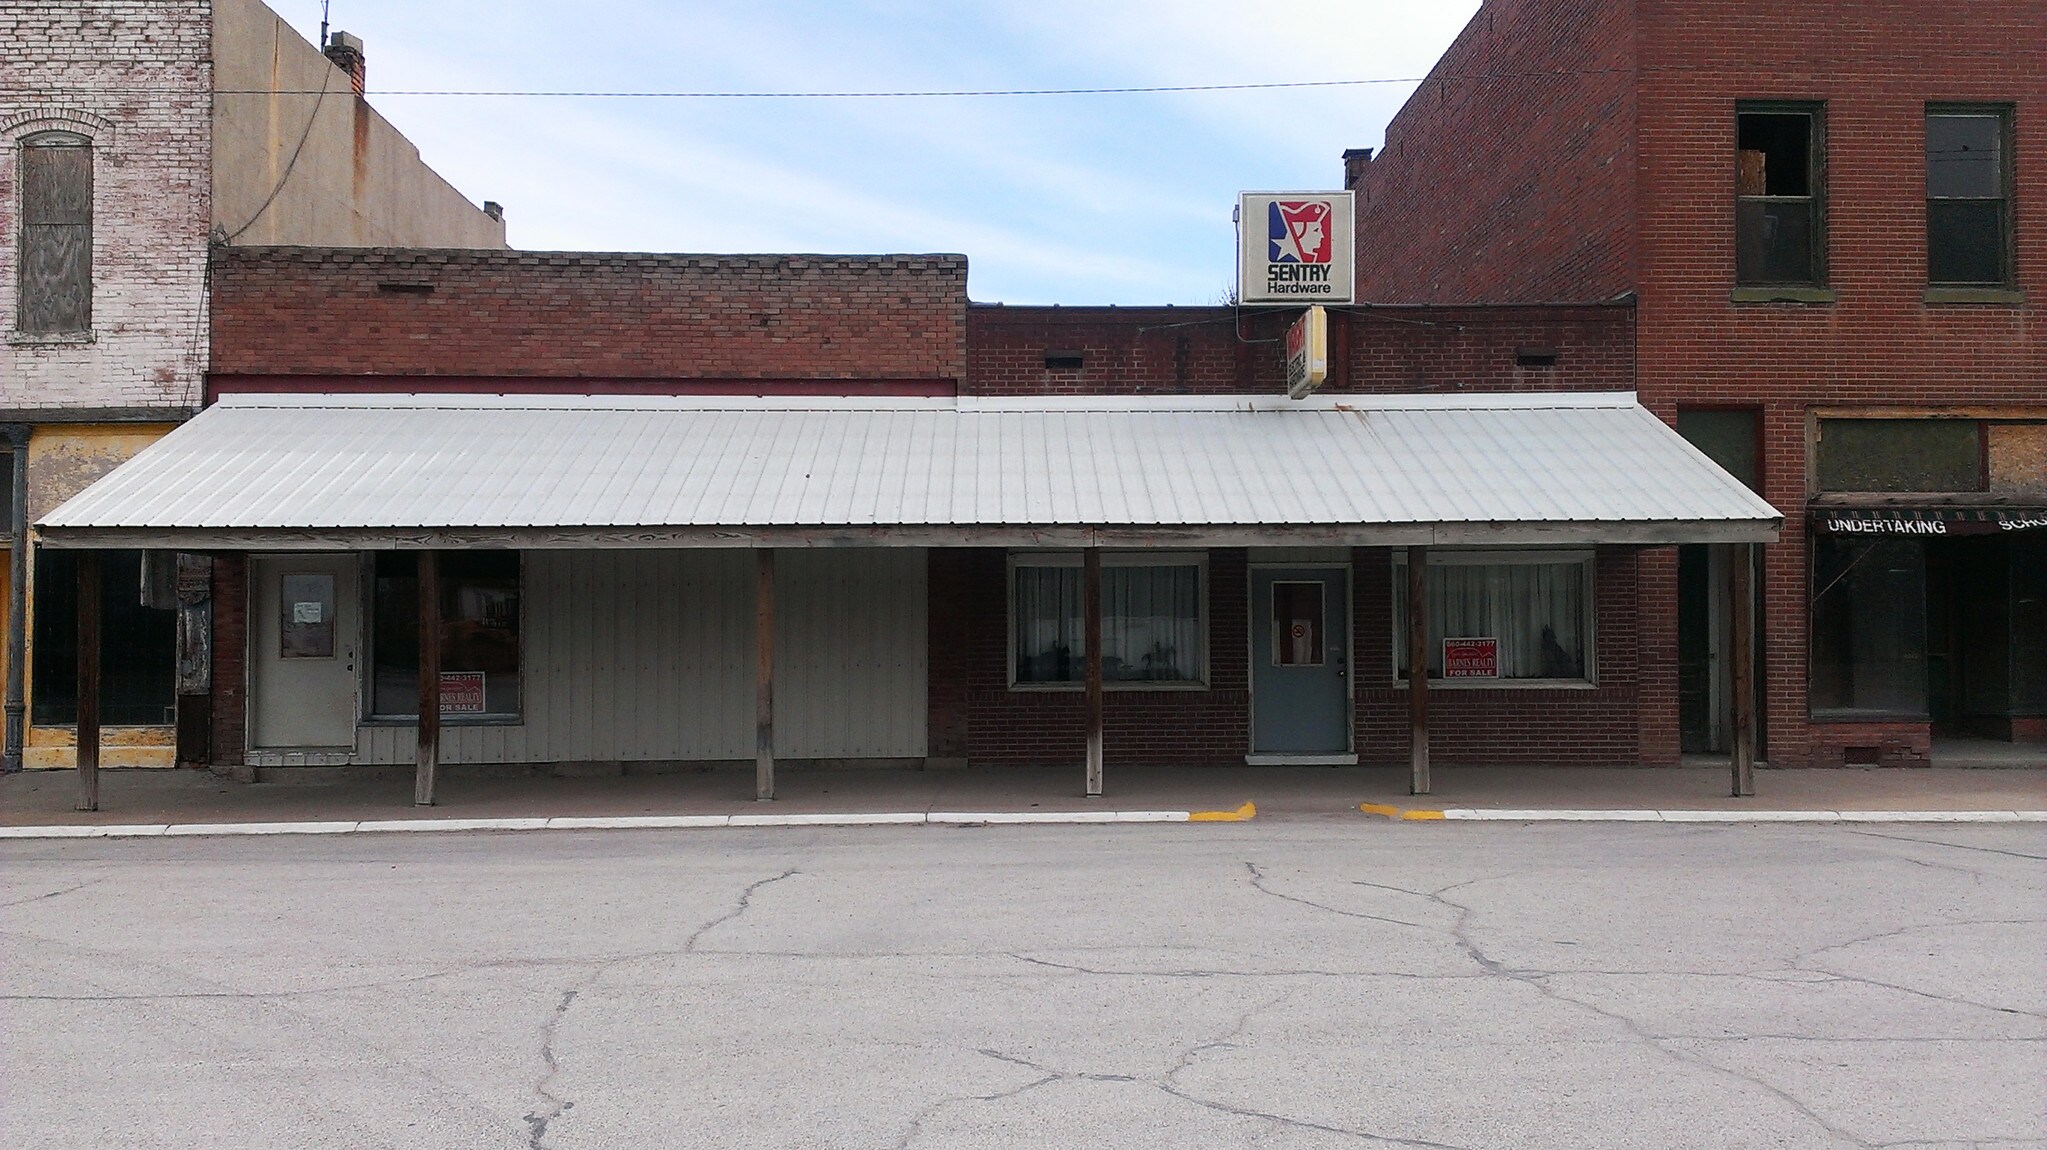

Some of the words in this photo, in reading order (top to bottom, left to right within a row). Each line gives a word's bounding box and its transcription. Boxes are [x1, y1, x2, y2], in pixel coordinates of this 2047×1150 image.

[1268, 264, 1331, 281] SENTRY
[1268, 282, 1331, 293] Hardware
[1827, 519, 1946, 533] UNDERTAKING
